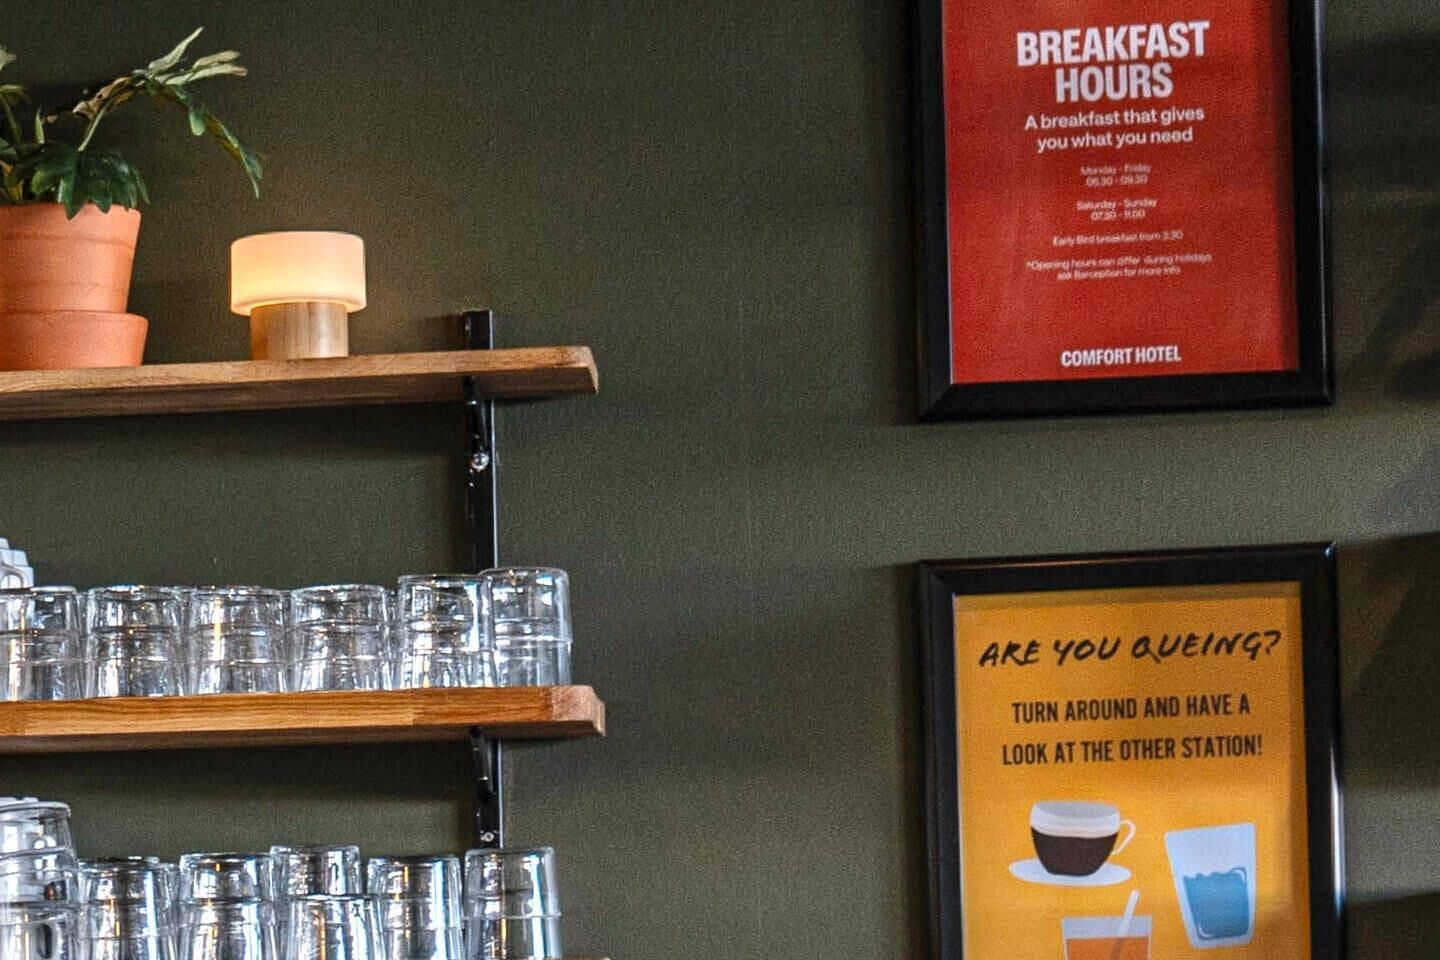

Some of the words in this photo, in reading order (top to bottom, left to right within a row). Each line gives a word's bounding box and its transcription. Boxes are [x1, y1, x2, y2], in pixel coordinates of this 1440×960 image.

[1016, 20, 1210, 67] BREAKFAST
[1055, 62, 1174, 103] HOURS
[1024, 115, 1038, 130] A
[1041, 110, 1120, 129] breakfast
[1123, 108, 1158, 124] that
[1160, 106, 1205, 126] gives
[1037, 136, 1068, 153] you
[1071, 132, 1112, 149] what
[1116, 132, 1147, 149] you
[1150, 127, 1193, 143] need
[1080, 165, 1117, 176] Monday
[1123, 163, 1152, 174] Friday
[1076, 200, 1116, 211] Saturday
[1123, 198, 1158, 209] Sunday
[1052, 235, 1075, 247] Early
[1076, 234, 1095, 245] Bird
[1096, 233, 1138, 244] breakfast
[1139, 231, 1161, 242] from
[1071, 258, 1096, 267] hours
[1098, 257, 1115, 266] can
[1143, 254, 1174, 265] during
[1174, 252, 1213, 264] holidays
[1137, 267, 1162, 276] more
[1061, 347, 1133, 367] COMFORT
[1135, 345, 1182, 363] HOTEL
[978, 639, 1040, 667] ARE
[1054, 637, 1121, 665] YOU
[1131, 630, 1282, 663] QUEING?
[1012, 702, 1058, 724] TURN
[1064, 698, 1137, 721] AROUND
[1143, 696, 1180, 717] AND
[1186, 694, 1233, 716] HAVE
[1239, 693, 1250, 714] A
[1002, 743, 1048, 765] LOOK
[1054, 741, 1075, 763] AT
[1080, 740, 1114, 762] THE
[1120, 738, 1175, 760] OTHER
[1181, 734, 1263, 759] STATION!
